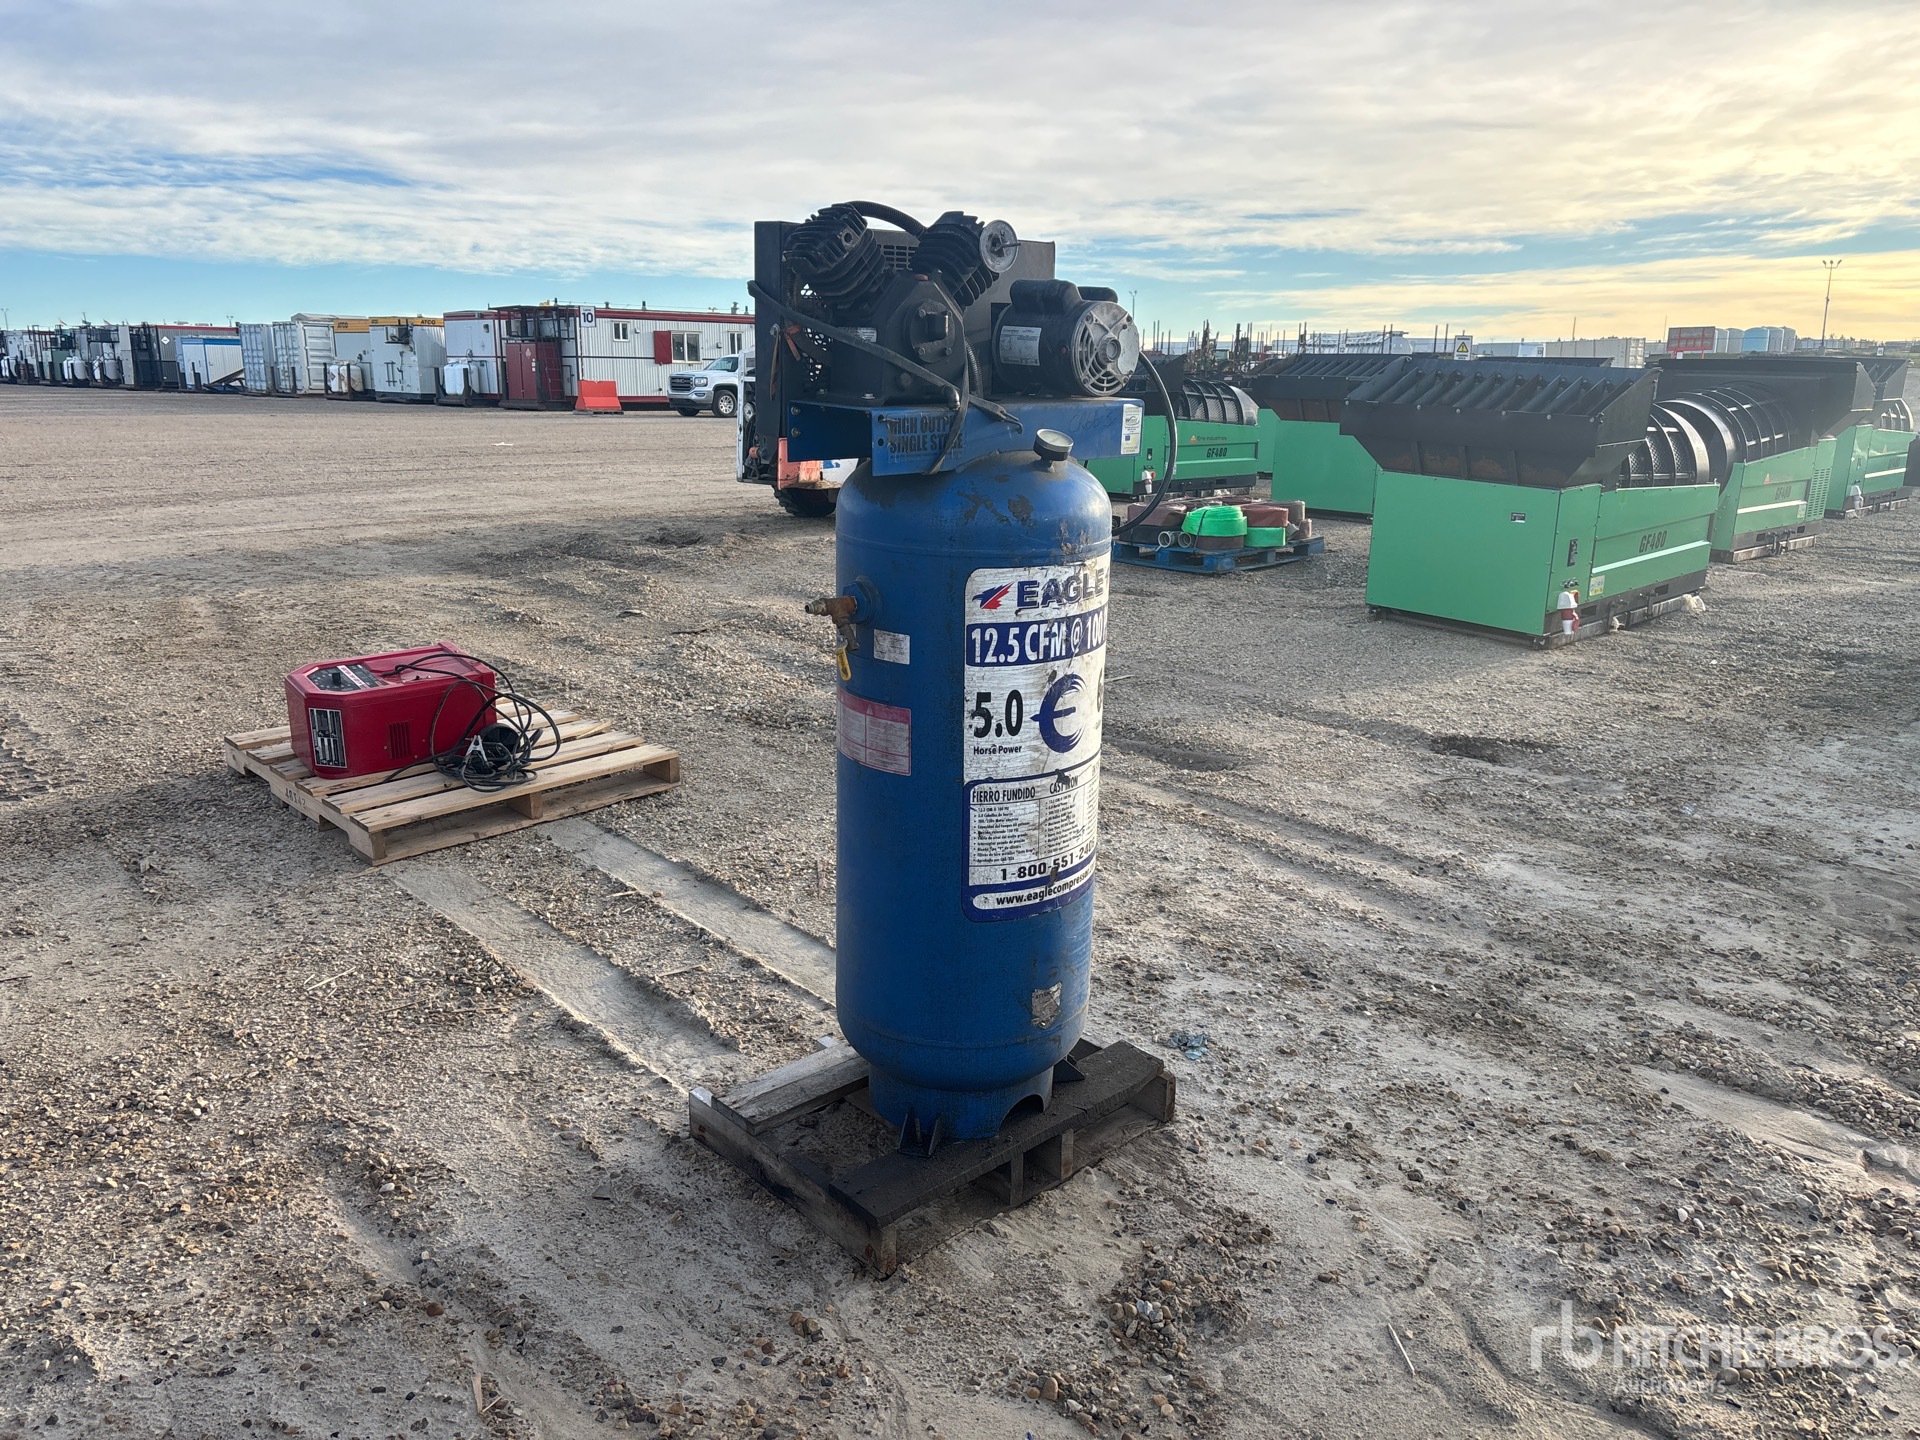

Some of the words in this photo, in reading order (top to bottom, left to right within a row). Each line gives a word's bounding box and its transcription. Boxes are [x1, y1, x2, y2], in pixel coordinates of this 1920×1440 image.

[582, 313, 594, 323] 10
[920, 413, 959, 434] OUTP
[889, 434, 928, 454] SINGLE
[929, 431, 963, 452] STE
[1206, 447, 1228, 458] GF480
[1639, 530, 1667, 553] GF480
[1016, 567, 1105, 610] EAGLE
[971, 689, 1024, 738] 5.0
[973, 744, 997, 755] Horse
[998, 745, 1022, 755] Power
[972, 788, 1000, 803] FIERRO
[1002, 786, 1036, 801] FUNDIDO
